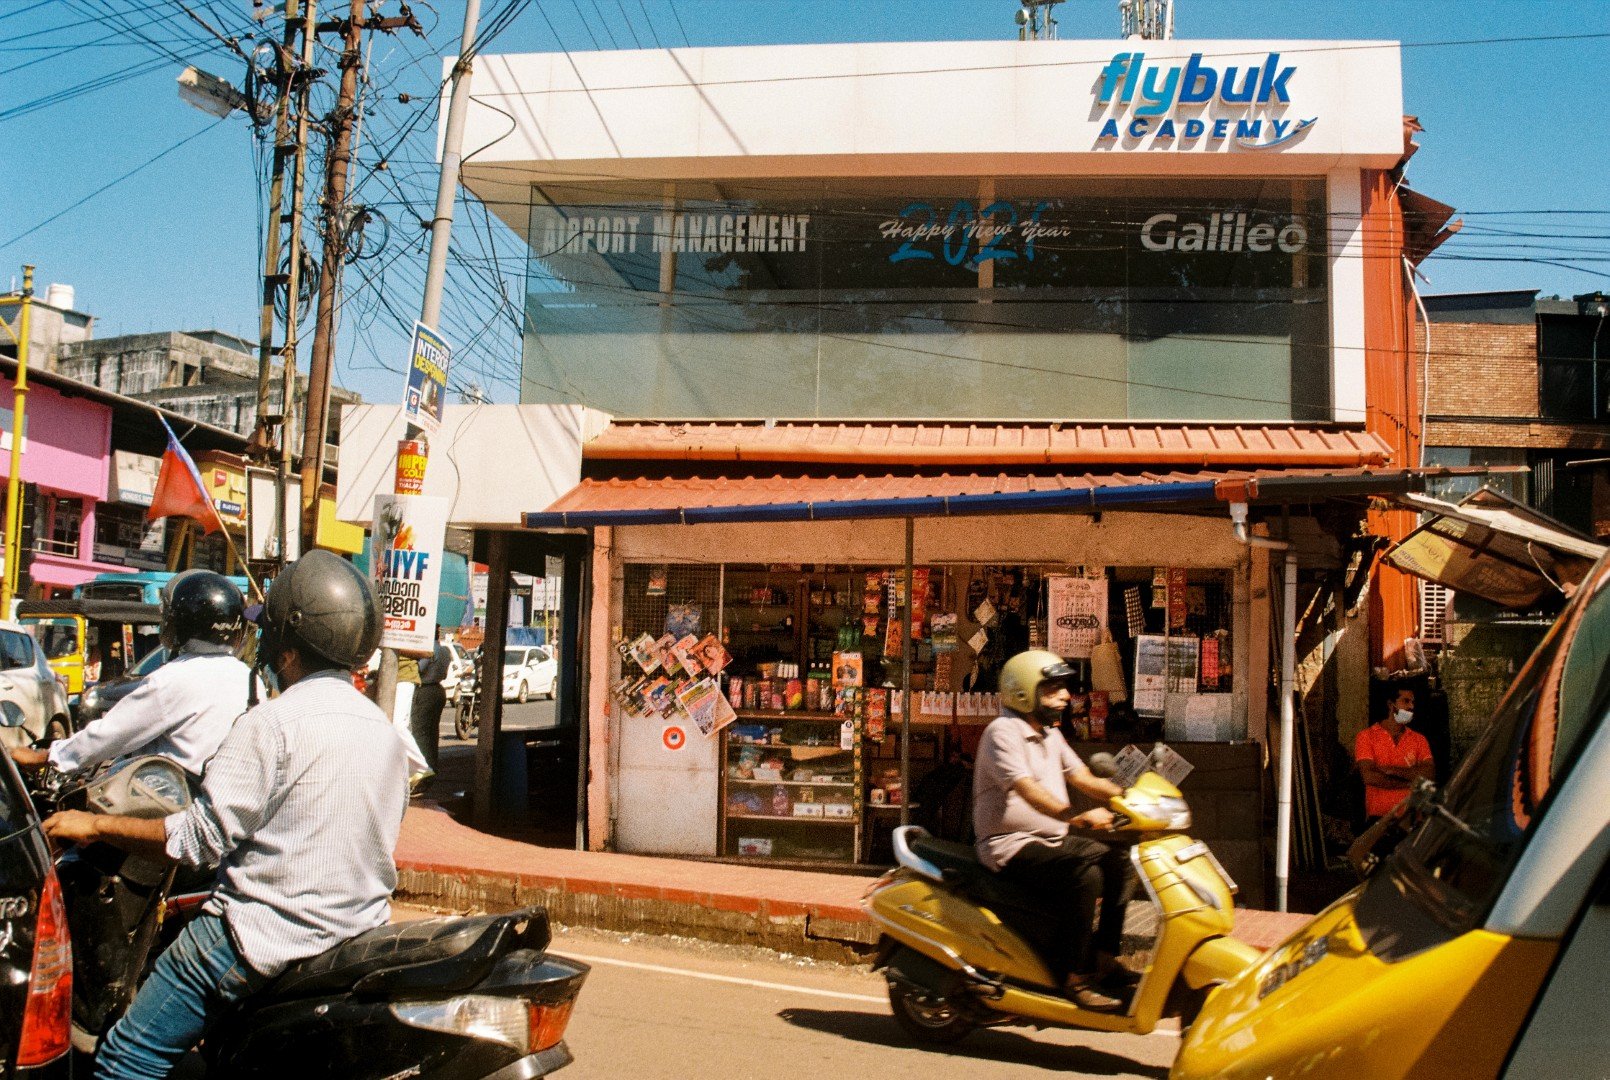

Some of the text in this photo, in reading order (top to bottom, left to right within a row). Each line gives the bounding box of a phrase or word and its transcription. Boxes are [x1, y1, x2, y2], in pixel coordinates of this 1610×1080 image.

[1099, 52, 1297, 117] flybuk
[1100, 118, 1291, 138] ACADEMY
[543, 213, 811, 254] AIRPORT MANAGEMENT
[878, 218, 1072, 243] Happy New Year
[889, 199, 1049, 266] 2021
[1140, 212, 1308, 253] Galileo
[382, 549, 430, 581] AIYF
